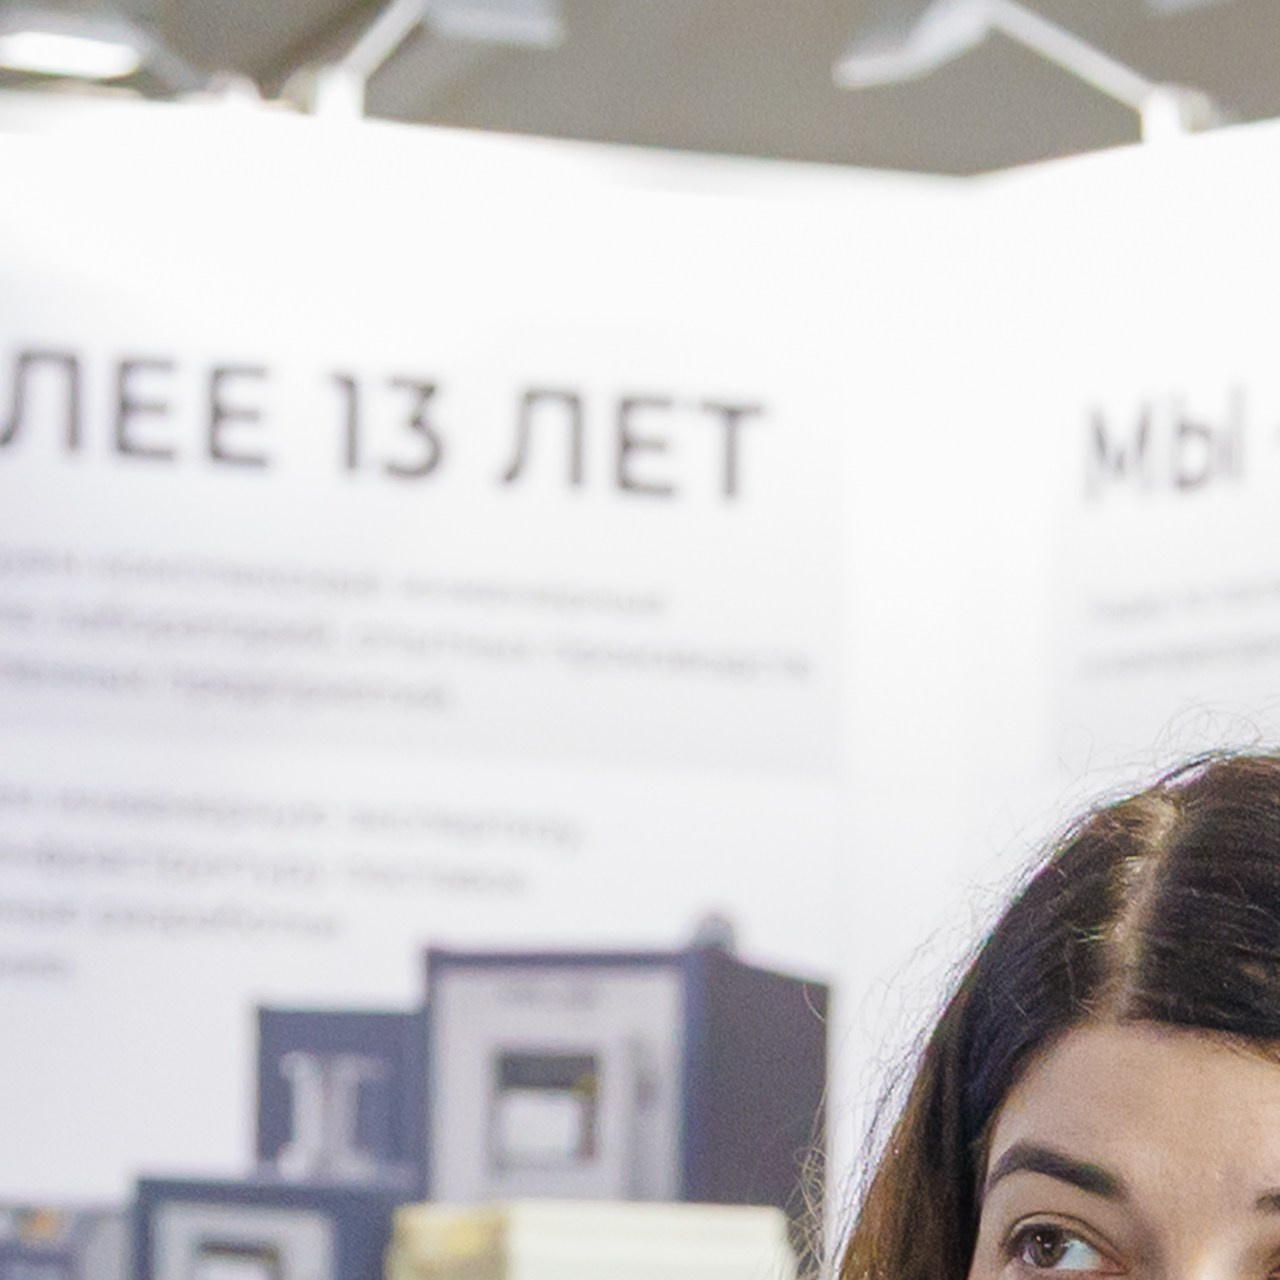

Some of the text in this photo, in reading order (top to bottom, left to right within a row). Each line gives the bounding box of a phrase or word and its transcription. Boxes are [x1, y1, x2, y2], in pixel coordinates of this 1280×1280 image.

[331, 365, 443, 478] 13
[500, 384, 767, 500] ЛЕТ
[1086, 386, 1243, 502] МЫ
